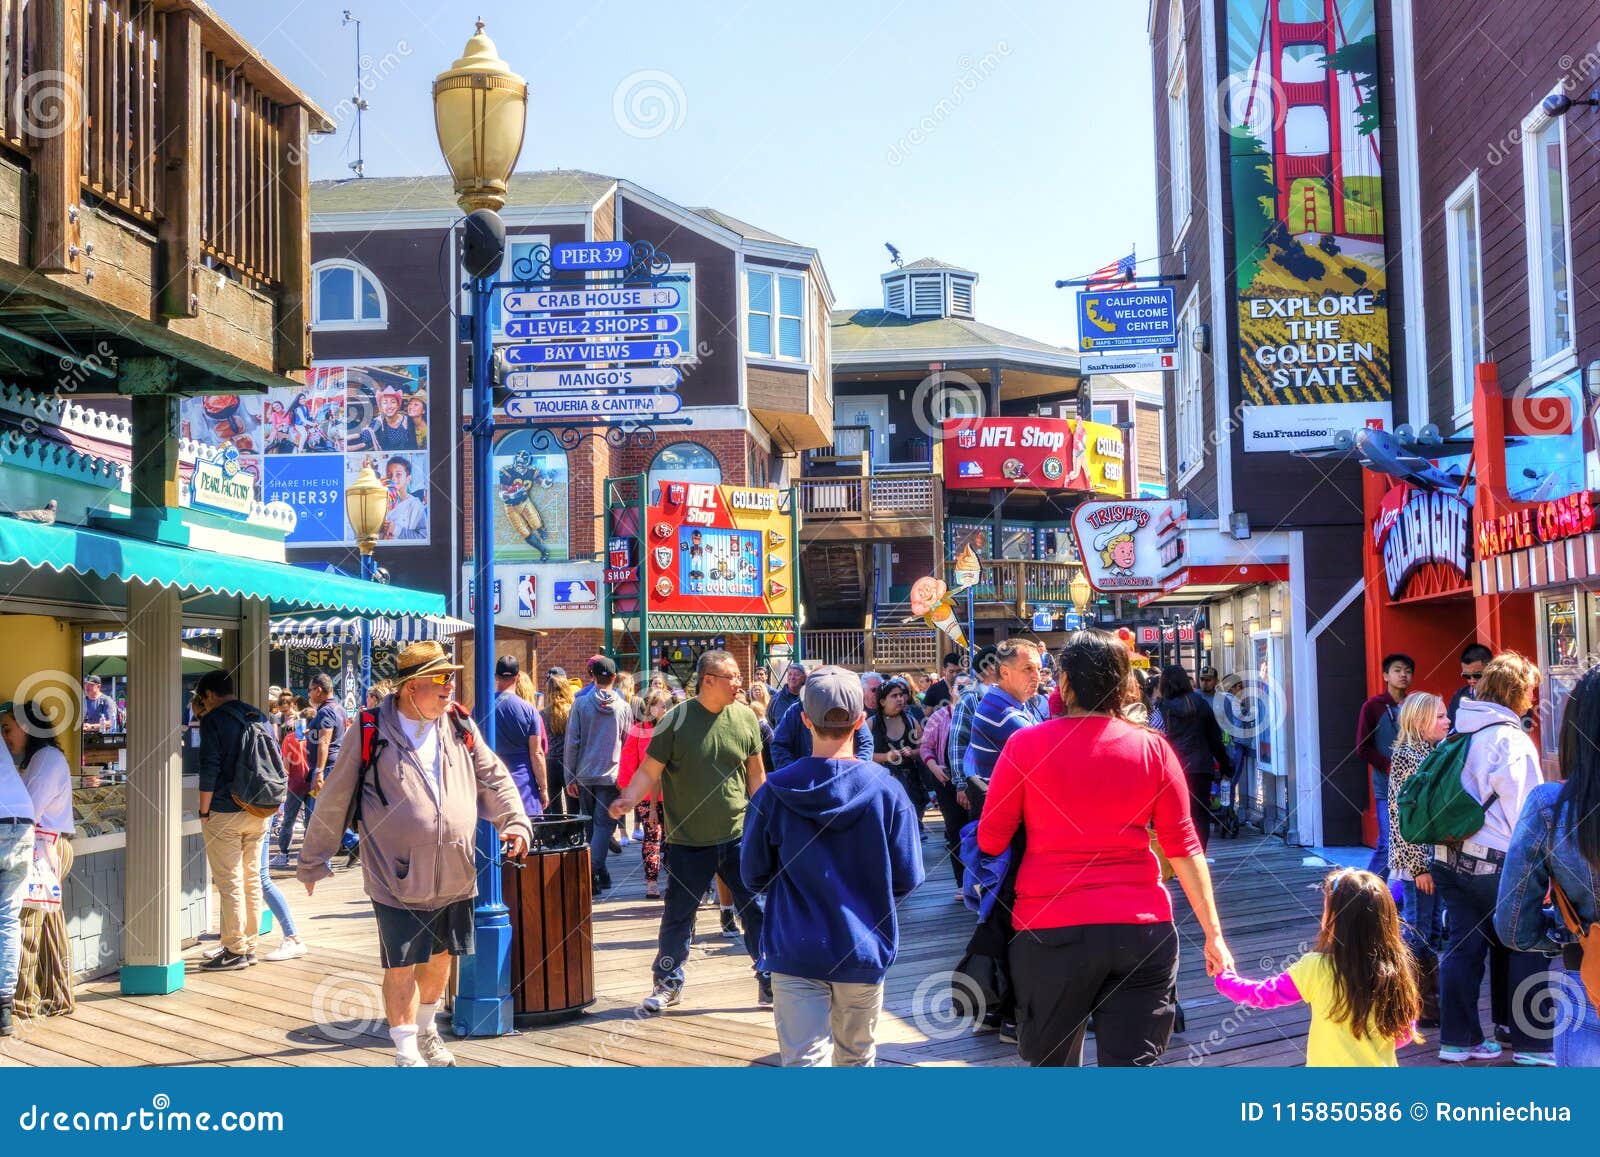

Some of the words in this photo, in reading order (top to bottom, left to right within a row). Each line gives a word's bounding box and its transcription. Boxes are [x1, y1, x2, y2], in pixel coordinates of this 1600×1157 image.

[560, 248, 605, 265] PIER
[605, 247, 623, 263] 39
[537, 294, 581, 308] CRAB
[585, 291, 641, 306] HOUSE
[1106, 295, 1168, 307] CALIFORNIA
[1250, 294, 1375, 318] EXPLORE
[1115, 308, 1169, 319] WELCOME
[528, 320, 577, 335] LEVEL
[582, 319, 590, 334] 2
[595, 317, 649, 332] SHOPS
[1126, 321, 1169, 332] CENTER
[1285, 319, 1341, 340] THE
[544, 347, 575, 361] BAY
[578, 344, 630, 360] VIEWS
[1255, 342, 1374, 364] GOLDEN
[558, 371, 633, 387] MANGO'S
[1273, 366, 1358, 388] STATE
[534, 400, 589, 413] TAQUERIA
[590, 399, 601, 411] &
[602, 398, 655, 411] CANTINA
[979, 426, 1016, 448] NFL
[1020, 426, 1065, 452] Shop
[201, 471, 221, 494] PEARL
[221, 476, 250, 502] FACTORY
[269, 479, 299, 488] SHARE
[303, 479, 319, 487] THE
[321, 479, 339, 487] FUN
[270, 490, 338, 505] #PIER39
[686, 484, 718, 508] NFL
[731, 490, 774, 511] COLLEGE
[686, 507, 716, 527] Shop
[1085, 505, 1150, 529] TRISH'S
[1478, 508, 1534, 560] WAFFLE
[1536, 489, 1596, 543] CONES
[1384, 490, 1432, 599] GOLDEN
[1431, 489, 1468, 576] GATE
[607, 569, 631, 581] SHOP
[729, 583, 754, 593] GIFTS
[307, 650, 330, 667] SF
